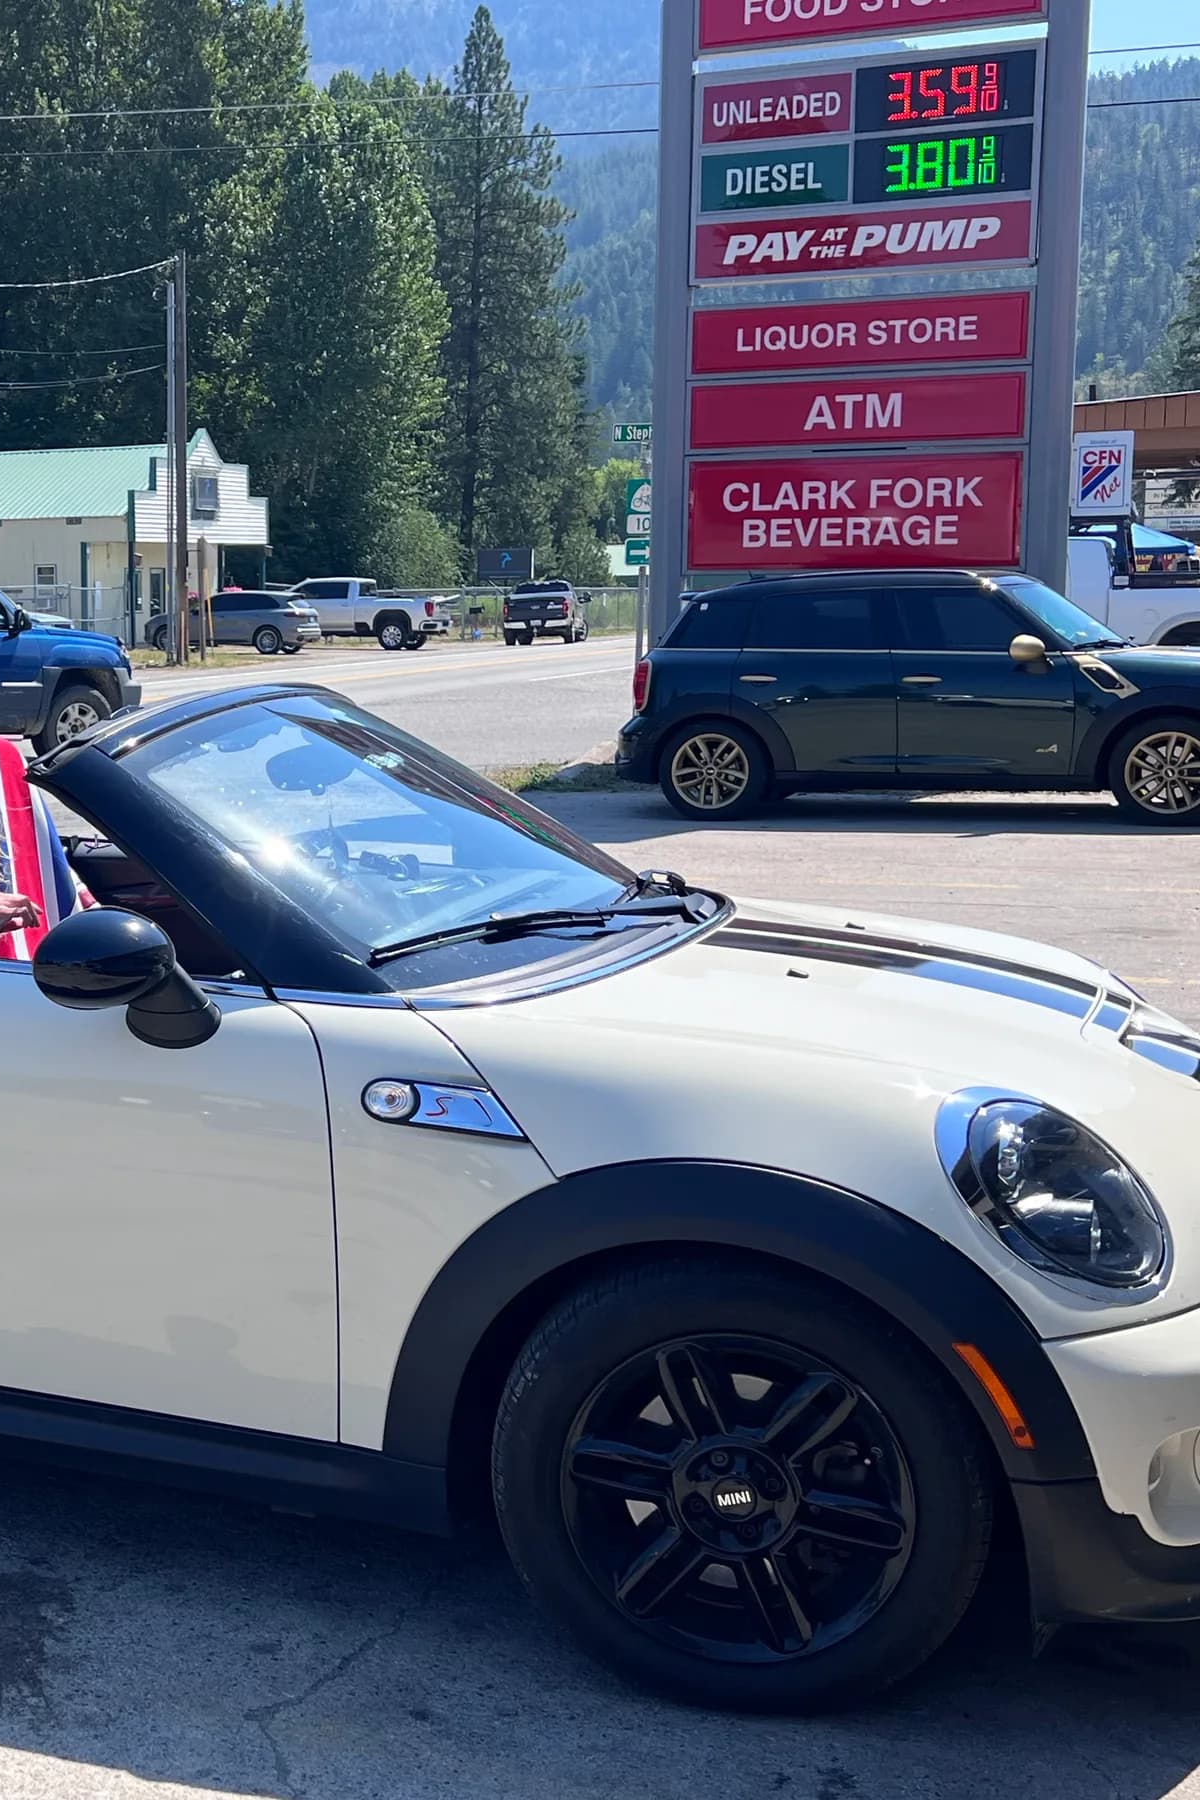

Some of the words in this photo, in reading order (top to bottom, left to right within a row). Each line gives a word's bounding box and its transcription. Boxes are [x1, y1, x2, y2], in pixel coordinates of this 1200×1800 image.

[712, 91, 841, 128] UNLEADED
[887, 64, 978, 121] 3.59
[725, 162, 822, 197] DIESEL
[885, 137, 976, 193] 3.80
[722, 228, 816, 266] PAY
[809, 243, 847, 260] THE
[820, 227, 848, 243] AT
[849, 216, 1002, 258] PUMP
[735, 321, 857, 353] LIQUOR
[866, 315, 979, 345] STORE
[802, 392, 903, 432] ATM
[614, 426, 622, 441] N
[1082, 449, 1122, 466] CFN
[722, 479, 857, 513] CLARK
[869, 475, 984, 510] FORK
[1093, 476, 1121, 503] Net
[742, 514, 959, 549] BEVERAGE
[716, 1490, 752, 1507] MINI
